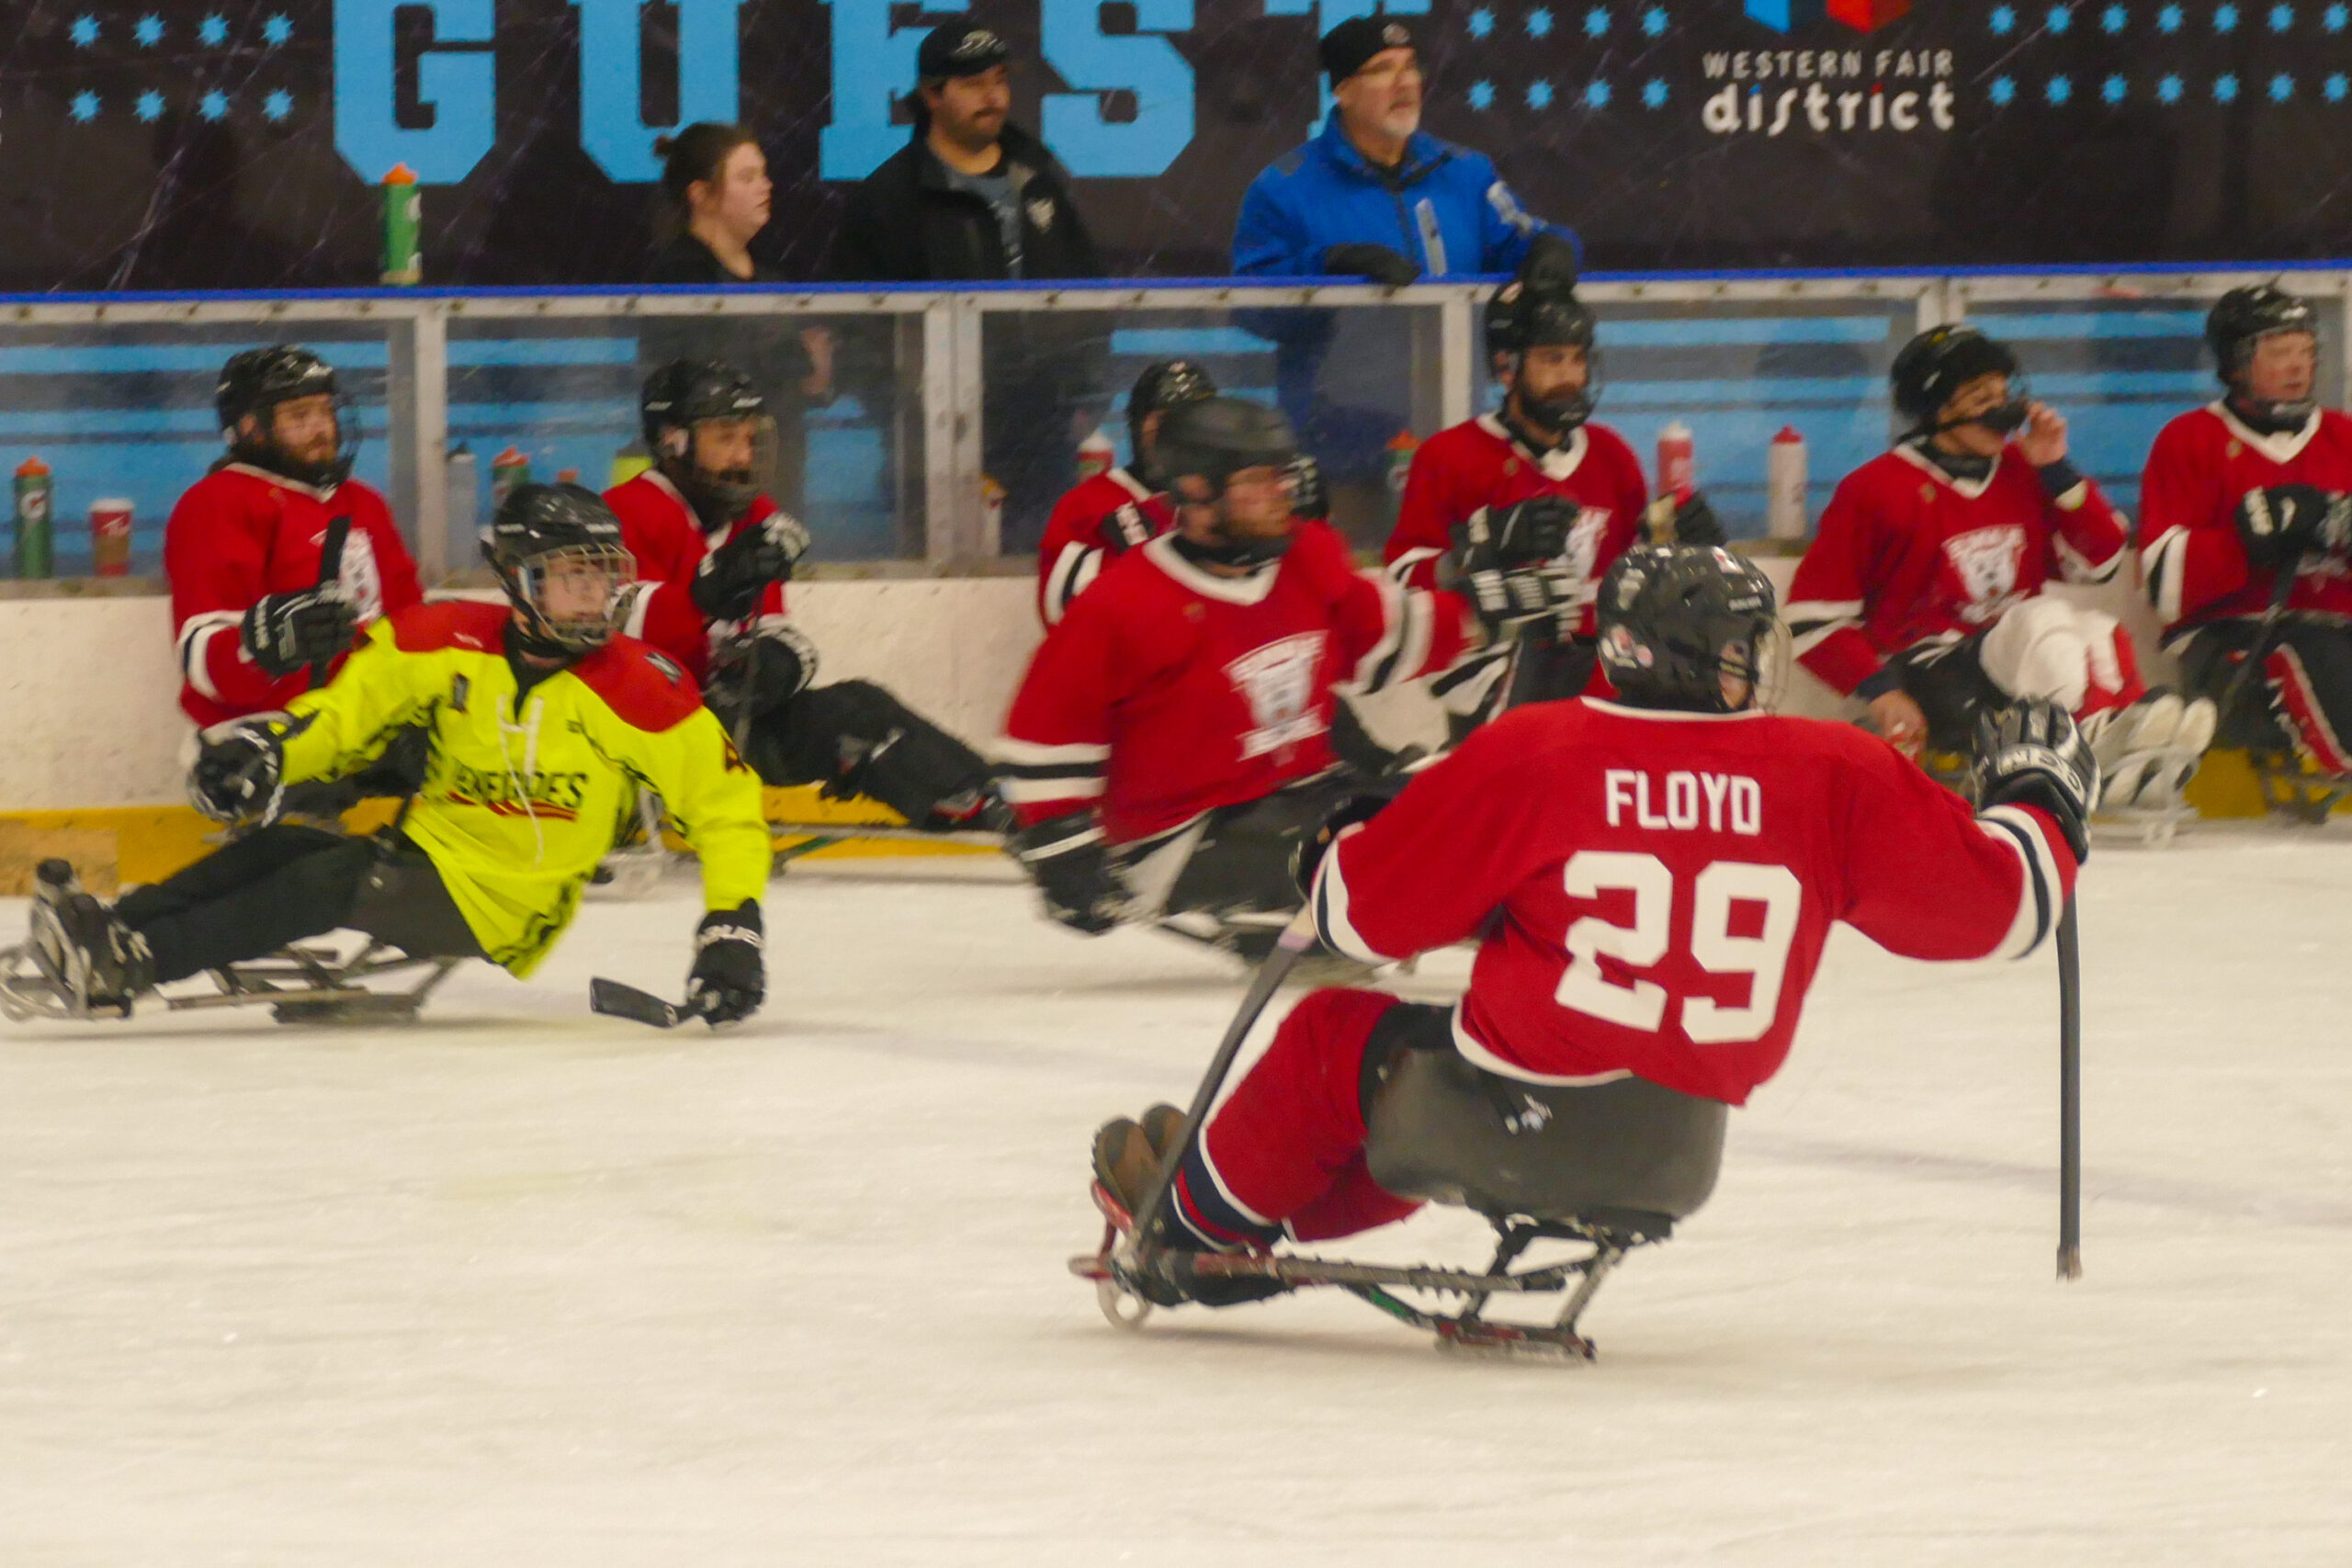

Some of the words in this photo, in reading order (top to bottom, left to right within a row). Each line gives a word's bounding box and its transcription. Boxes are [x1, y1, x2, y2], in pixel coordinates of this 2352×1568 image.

[333, 0, 1430, 186] GUES
[1702, 50, 1861, 80] WESTERN
[1875, 49, 1953, 77] FAIR
[1702, 82, 1955, 137] district
[1605, 769, 1762, 836] FLOYD
[1554, 850, 1803, 1044] 29
